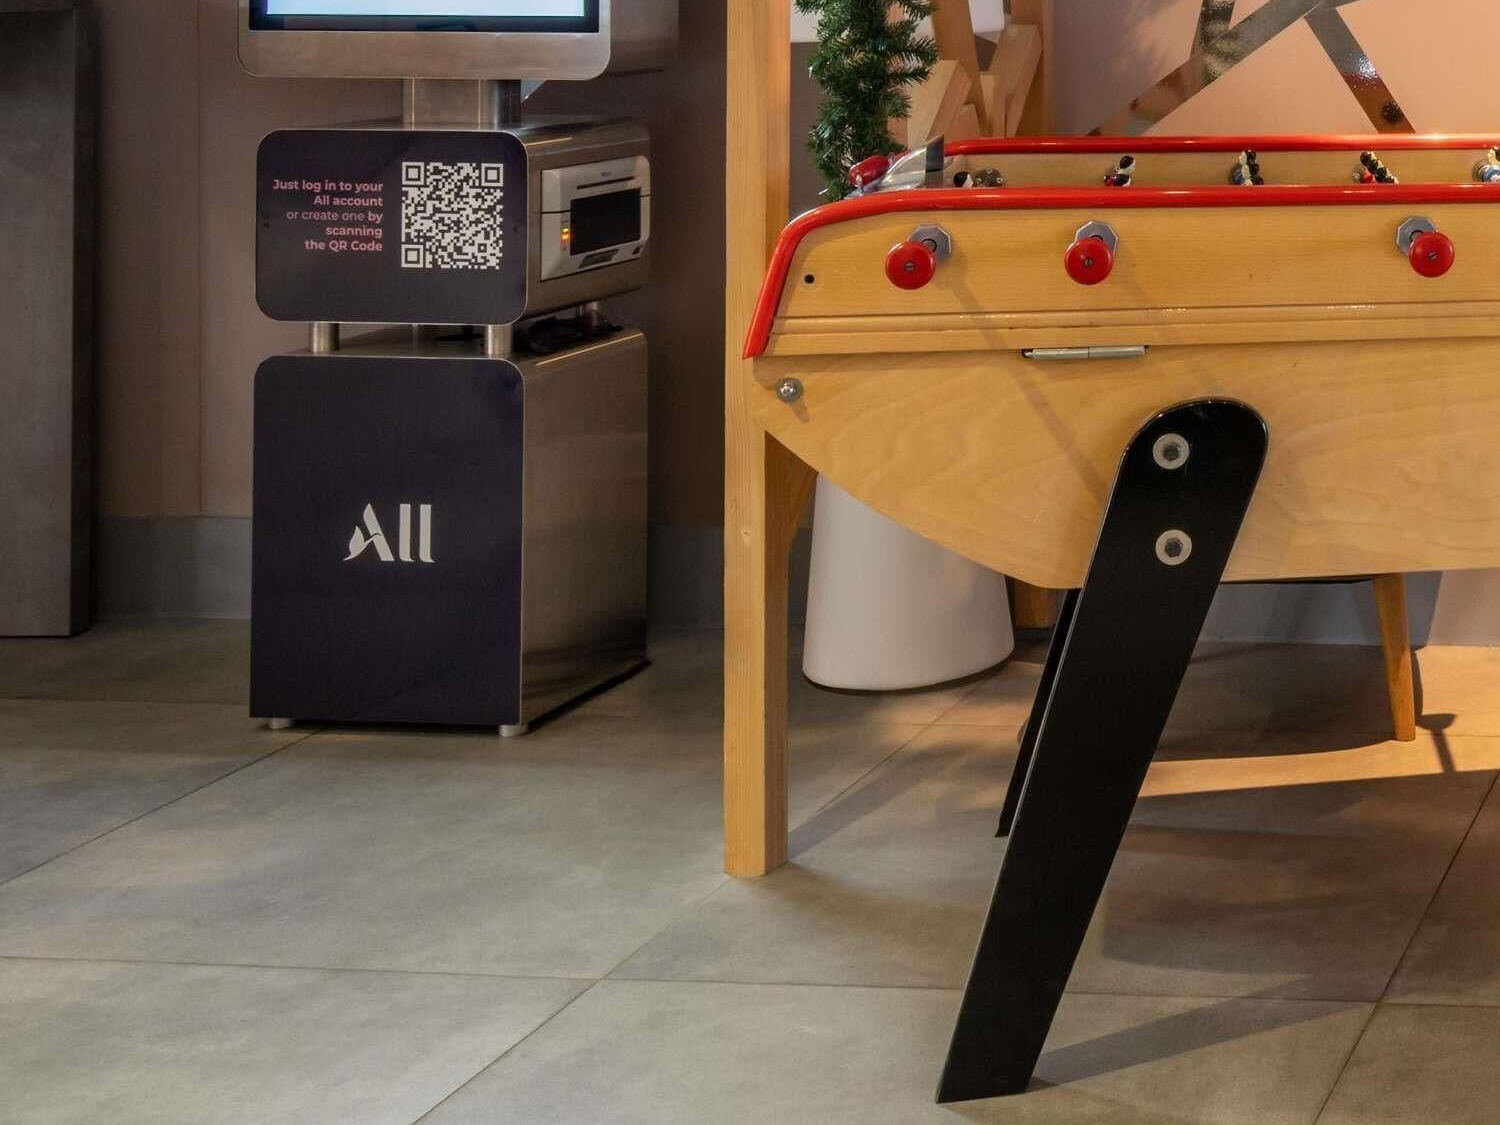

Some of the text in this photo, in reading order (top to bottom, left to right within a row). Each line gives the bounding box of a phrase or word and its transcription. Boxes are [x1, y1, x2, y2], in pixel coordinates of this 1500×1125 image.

[272, 179, 383, 193] Just log in to your
[313, 195, 383, 206] All account
[286, 211, 383, 223] or create one by
[326, 225, 382, 238] scanning
[305, 239, 382, 252] the QR Code
[343, 502, 435, 562] All
